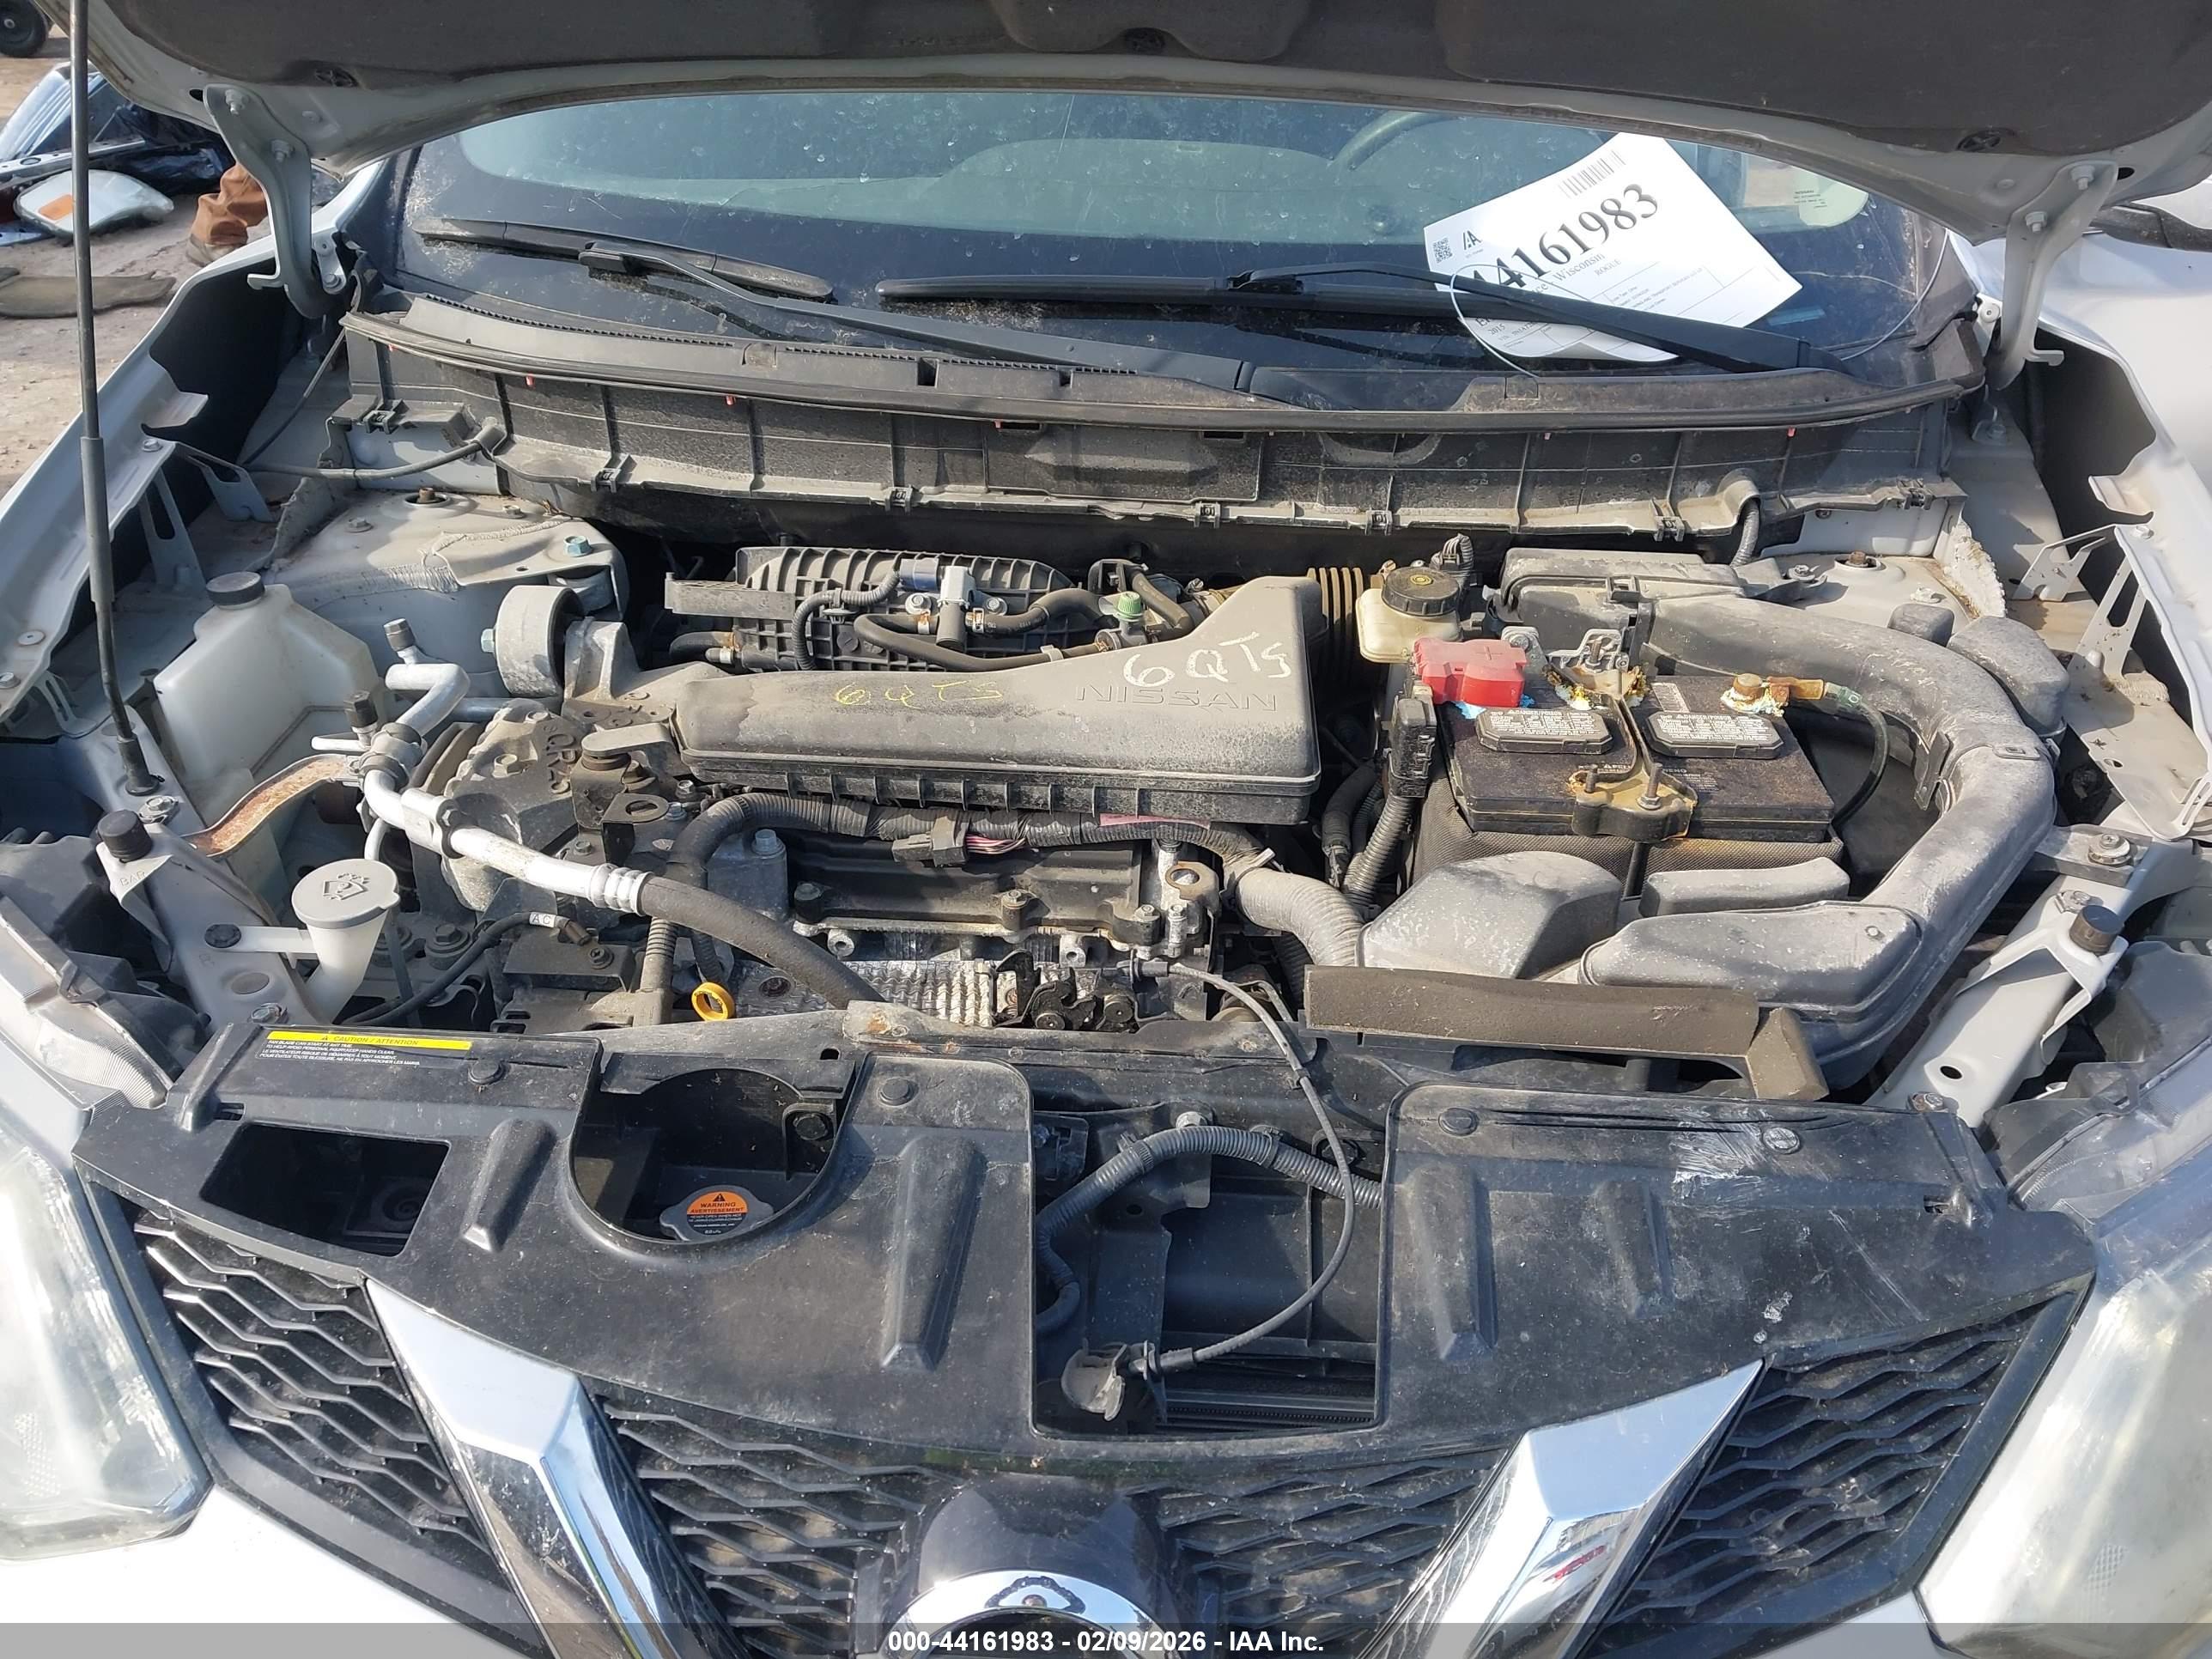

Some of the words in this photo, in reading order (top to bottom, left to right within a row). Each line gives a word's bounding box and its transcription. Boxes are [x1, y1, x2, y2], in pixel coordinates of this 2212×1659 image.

[1553, 253, 1606, 283] Wisconsin
[1487, 322, 1506, 336] 2015
[1122, 653, 1176, 688] 6
[1075, 684, 1278, 713] NISSAN
